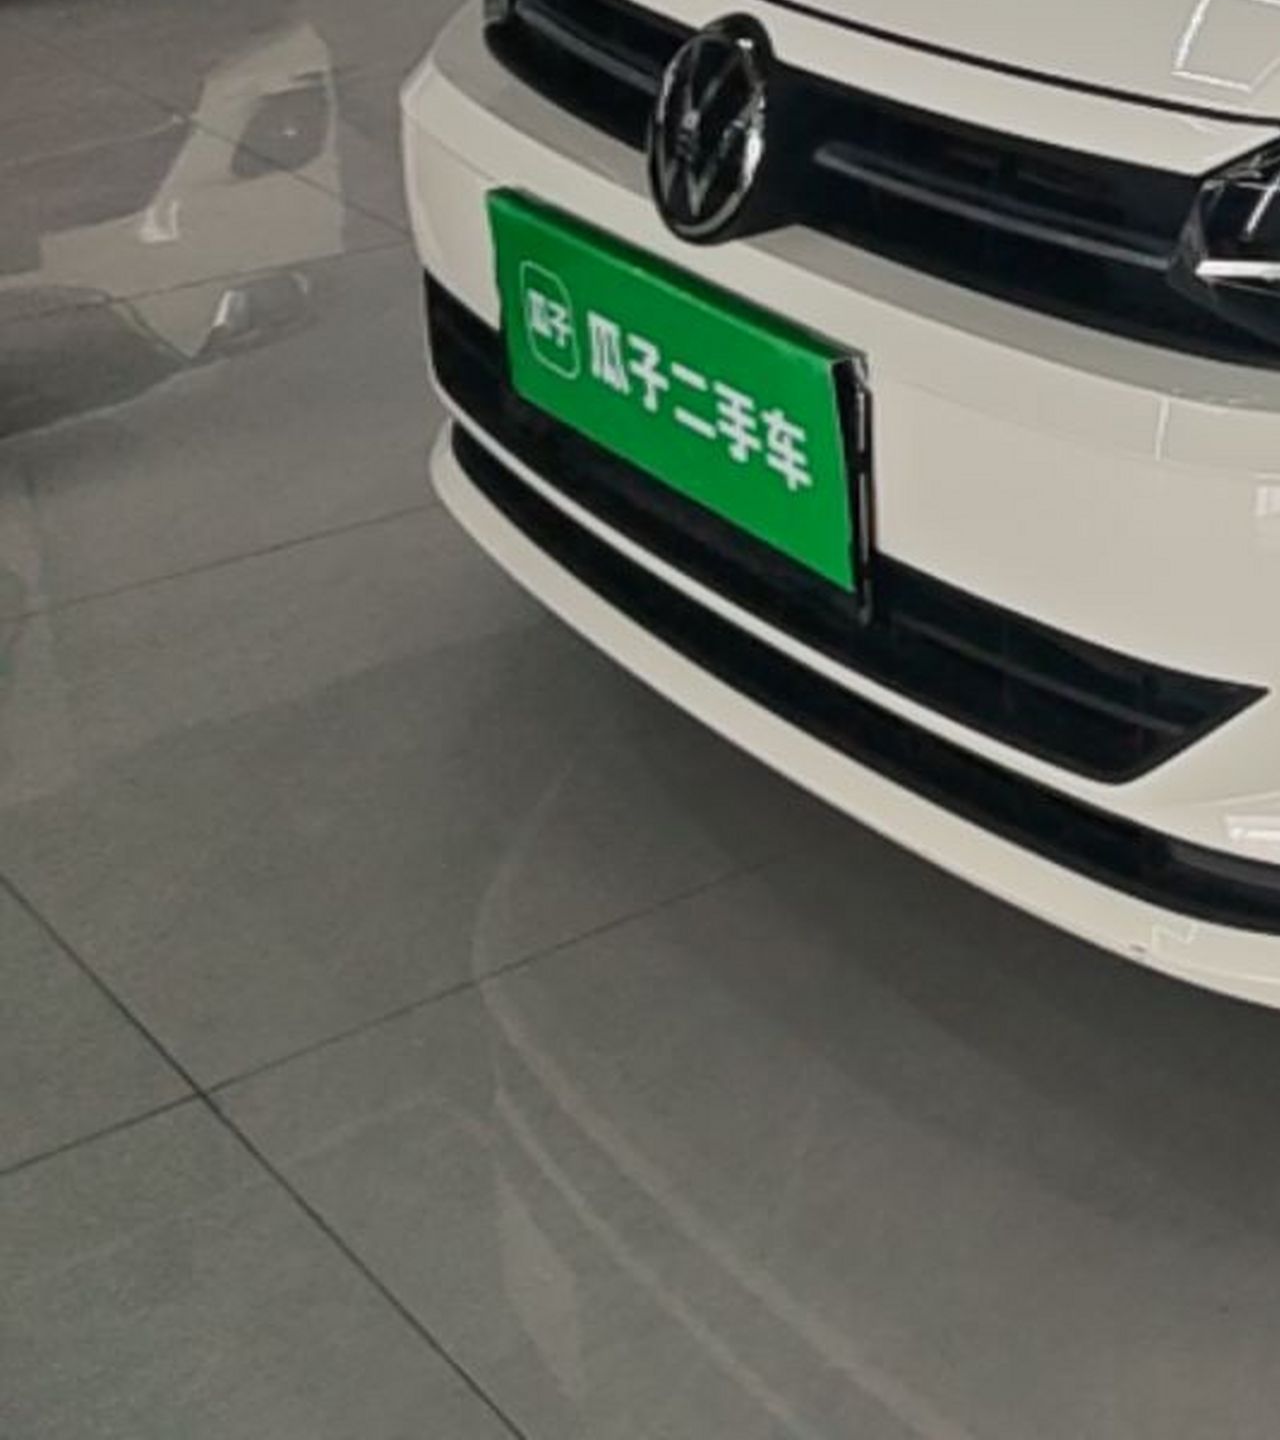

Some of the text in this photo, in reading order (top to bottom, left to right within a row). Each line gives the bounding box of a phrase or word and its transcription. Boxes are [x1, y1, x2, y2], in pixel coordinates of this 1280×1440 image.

[586, 309, 813, 493] 瓜子二手车
